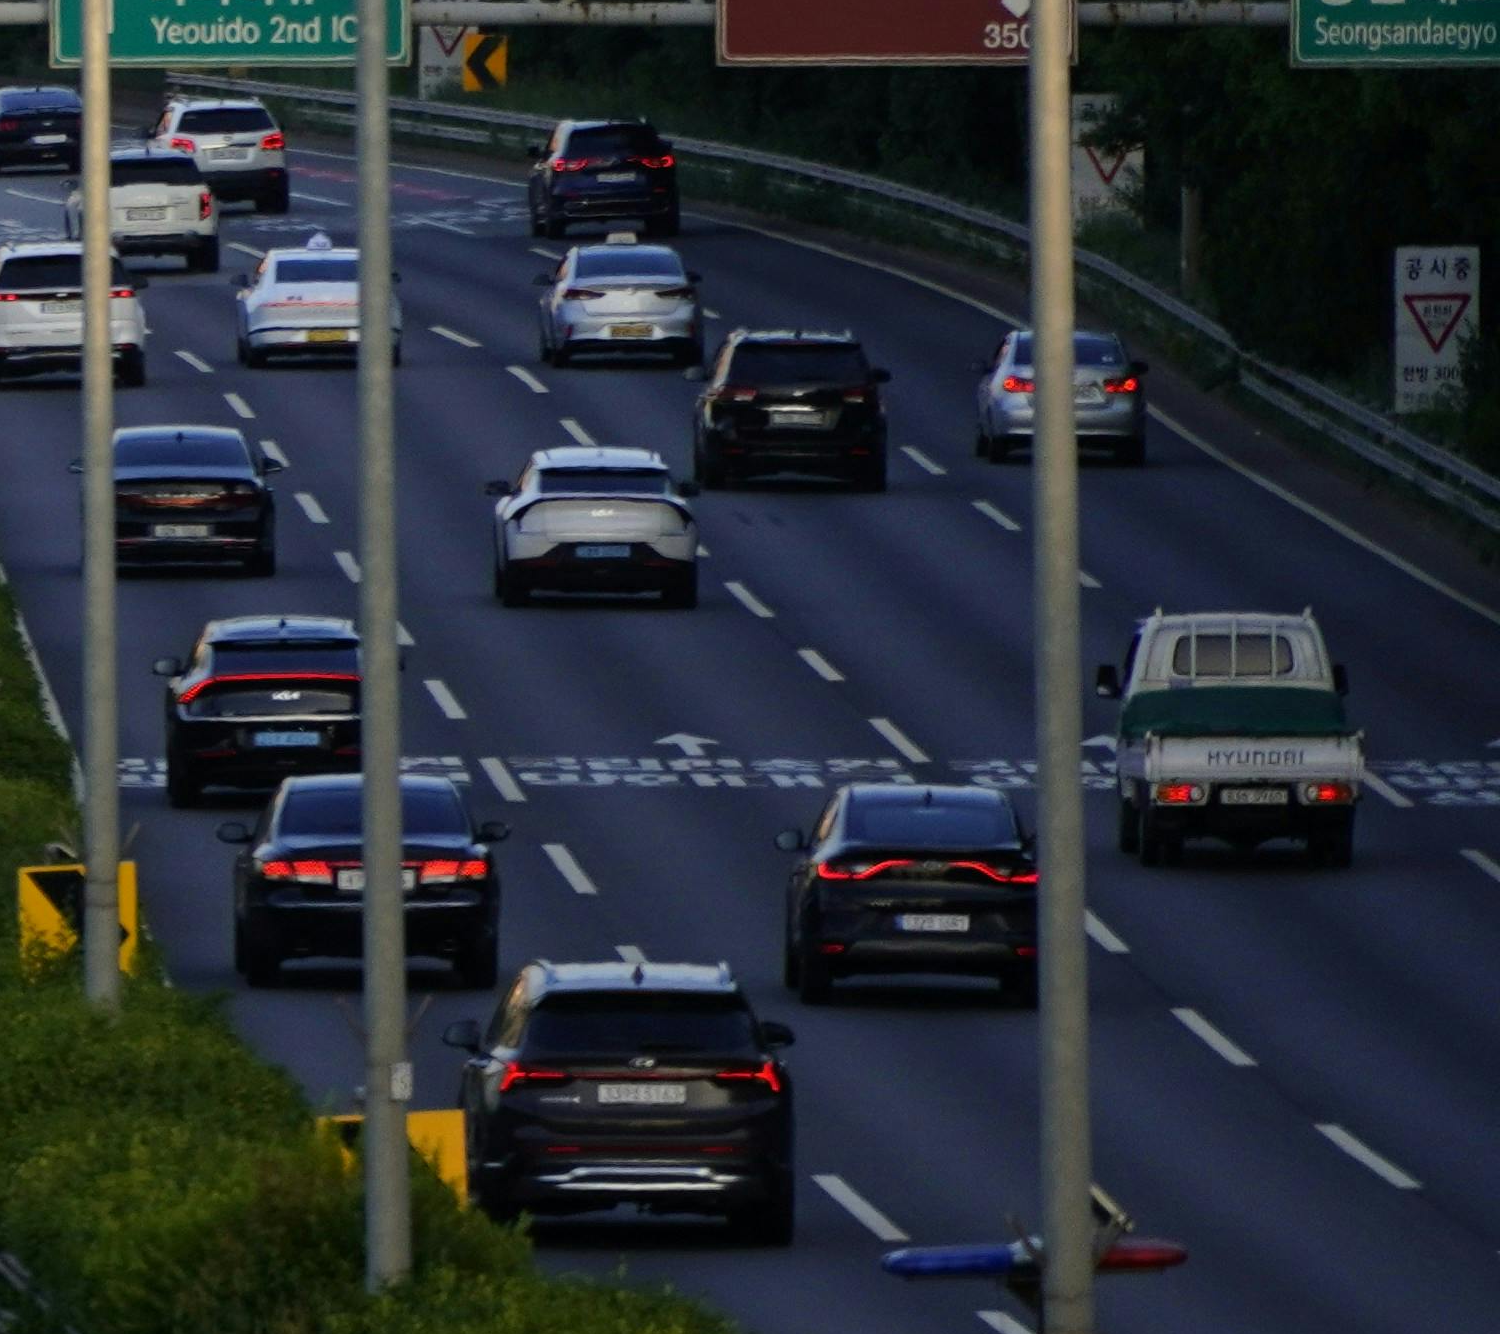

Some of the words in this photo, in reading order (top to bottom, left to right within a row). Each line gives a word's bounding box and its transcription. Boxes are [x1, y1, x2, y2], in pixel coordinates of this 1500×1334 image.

[151, 16, 261, 46] Yeouido
[270, 16, 321, 44] 2nd
[332, 17, 359, 44] IC
[1315, 16, 1497, 51] Seongsandaegyo
[1207, 750, 1305, 766] HYUNDAI
